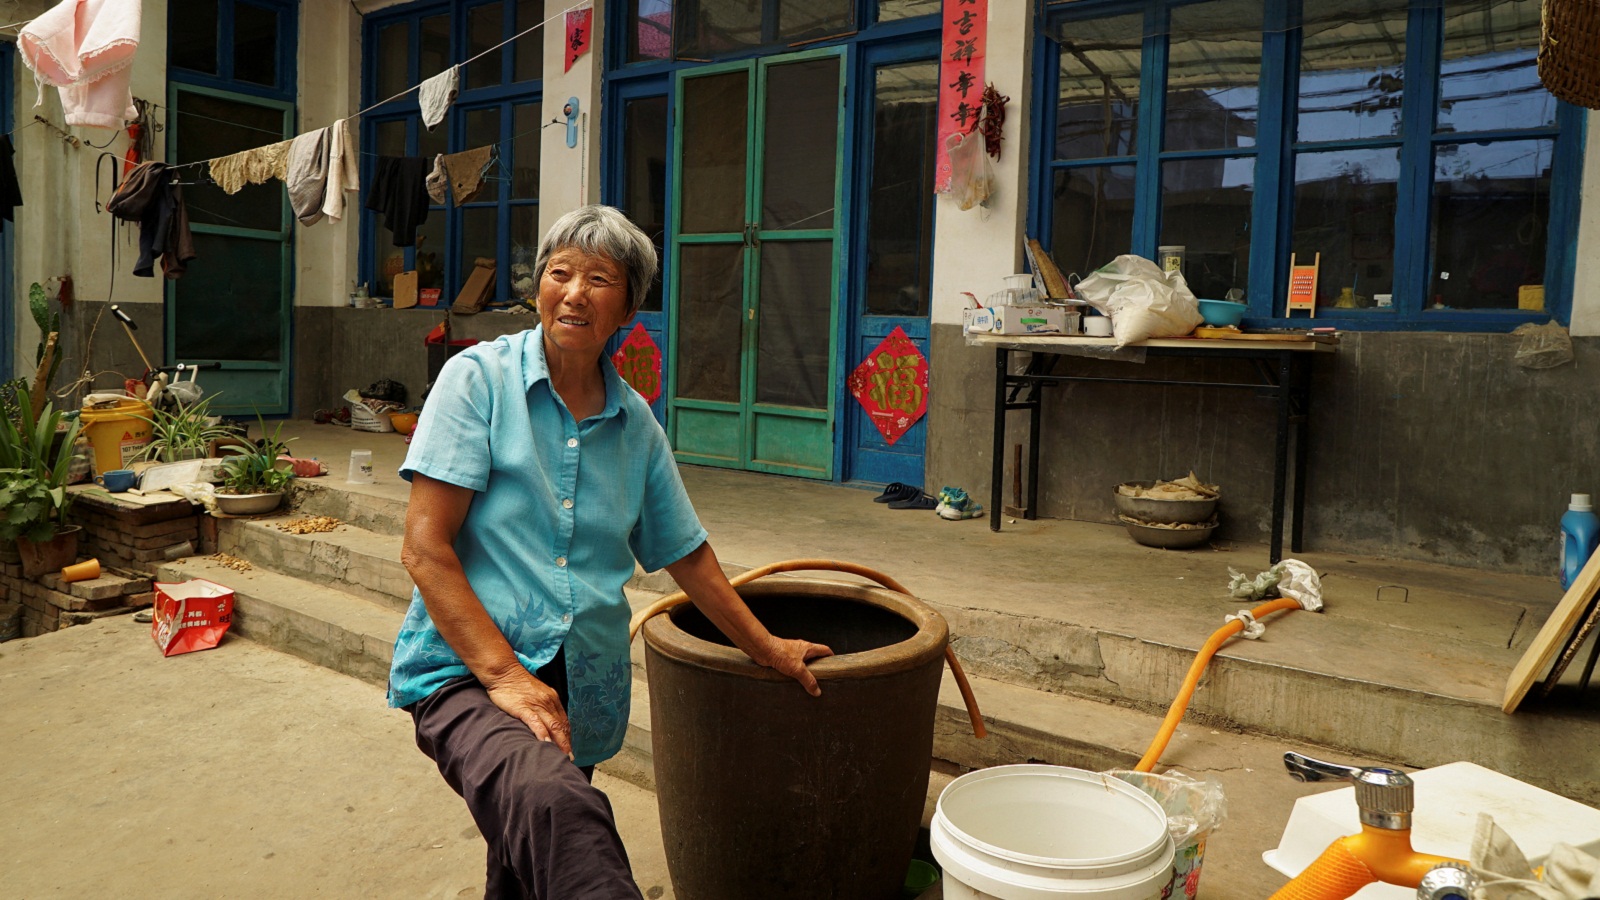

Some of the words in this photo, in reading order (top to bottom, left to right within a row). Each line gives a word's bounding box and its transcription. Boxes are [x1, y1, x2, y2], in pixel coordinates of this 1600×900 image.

[569, 27, 585, 63] 家
[949, 0, 977, 137] 吉祥年年
[622, 343, 658, 396] 福
[869, 351, 923, 415] 福
